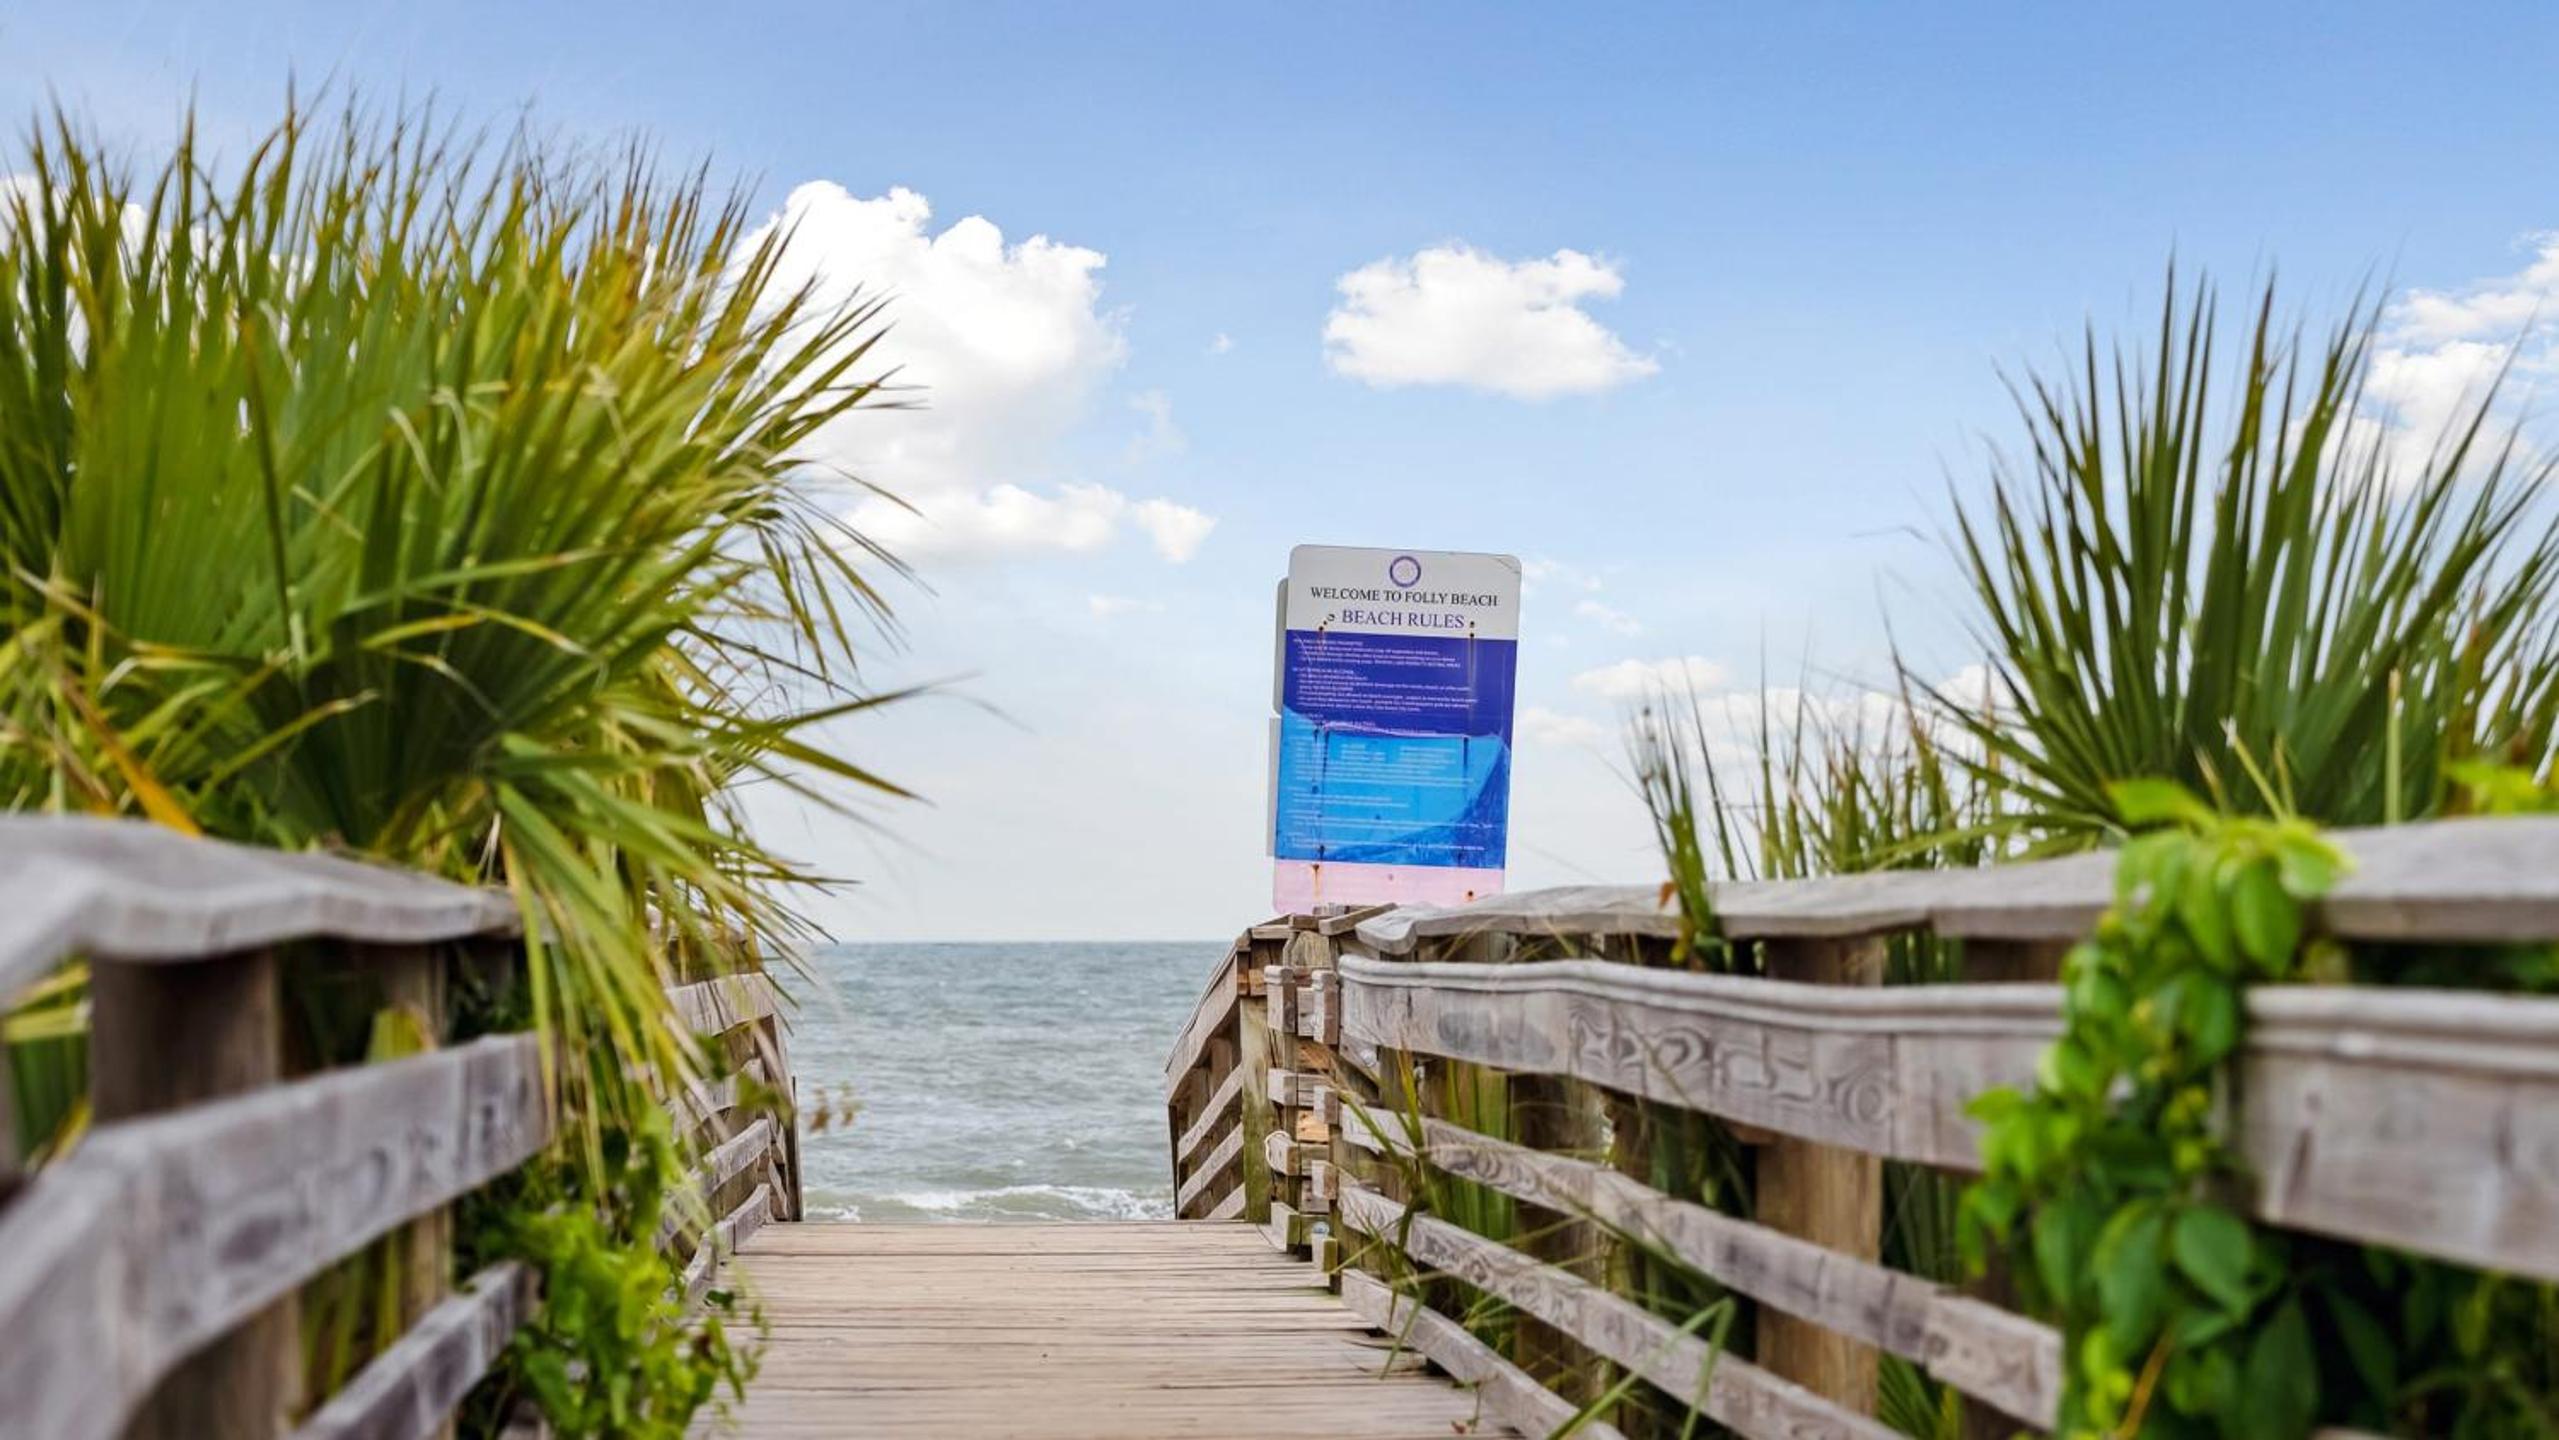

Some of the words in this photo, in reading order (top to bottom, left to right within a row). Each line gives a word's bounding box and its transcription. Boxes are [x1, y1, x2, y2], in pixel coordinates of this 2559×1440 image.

[1311, 587, 1380, 601] WELCOME
[1383, 590, 1402, 602] TO
[1405, 591, 1448, 605] FOLLY
[1451, 593, 1498, 606] BEACH
[1342, 609, 1402, 627] BEACH
[1407, 611, 1465, 628] RULES
